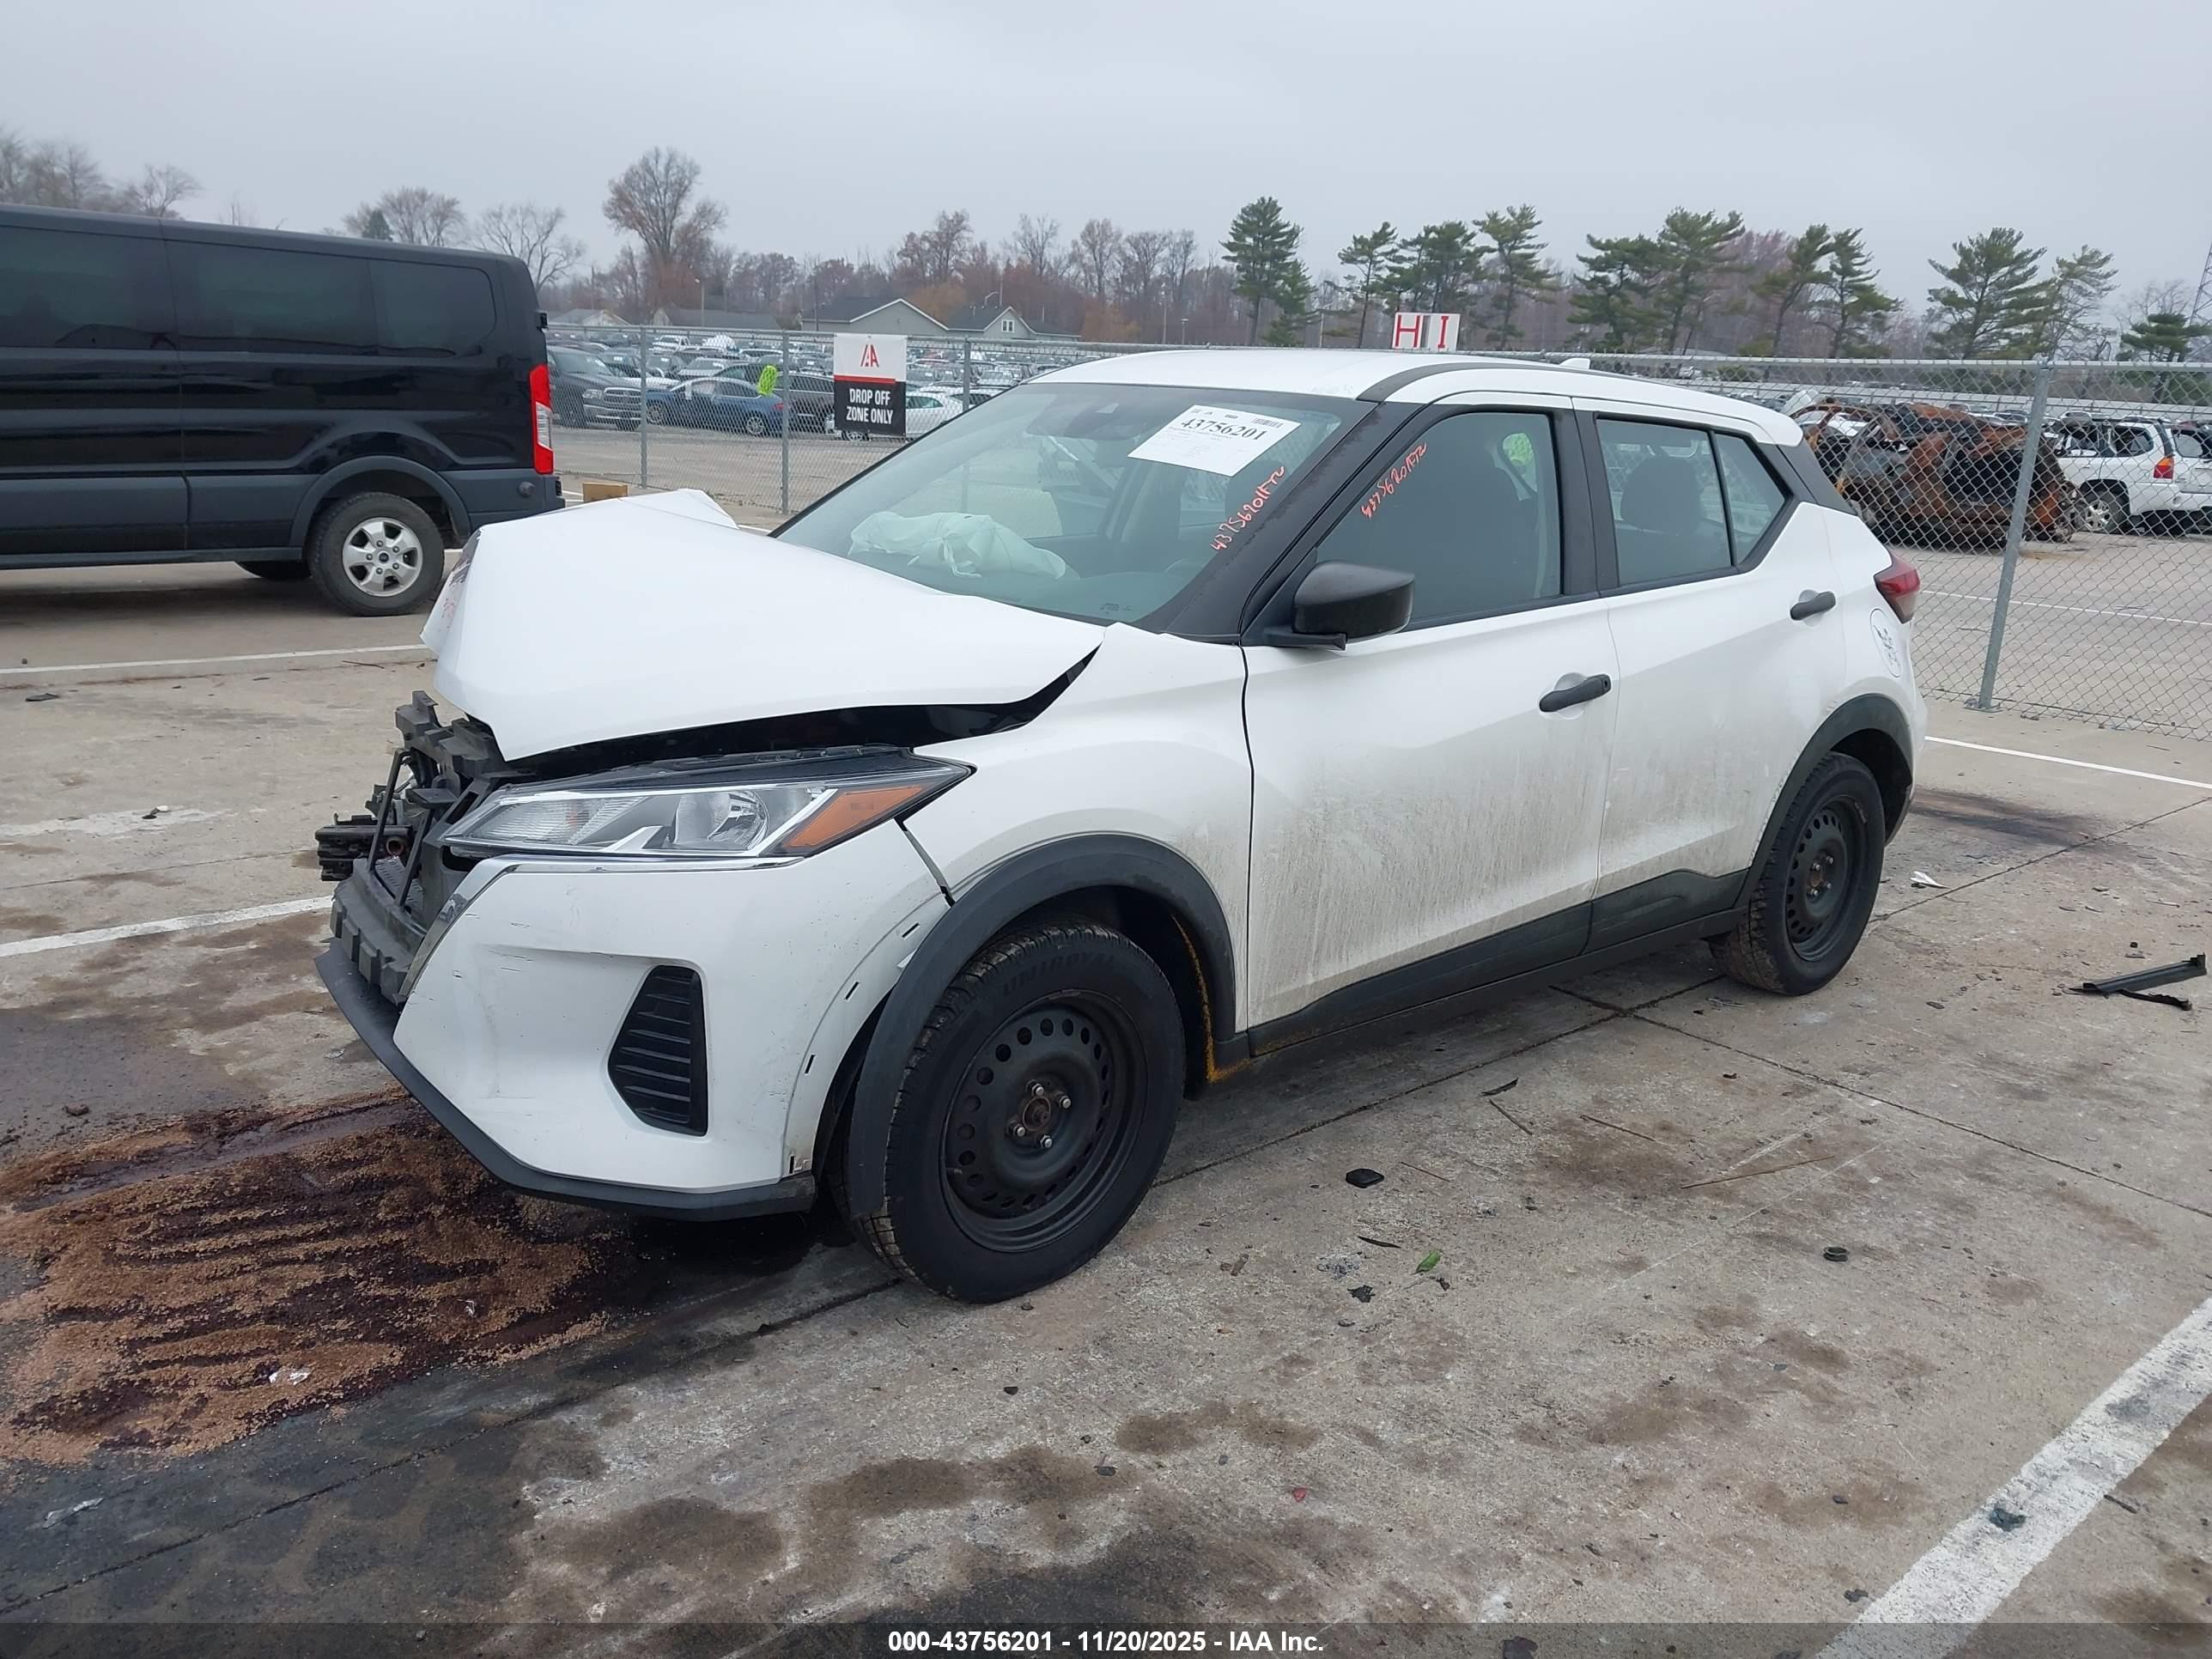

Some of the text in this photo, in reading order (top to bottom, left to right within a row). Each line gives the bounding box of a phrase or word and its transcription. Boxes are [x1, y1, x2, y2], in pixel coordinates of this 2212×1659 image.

[849, 388, 891, 406] DROP OFF
[846, 406, 894, 425] ZONE ONLY
[1181, 417, 1267, 441] 43756201
